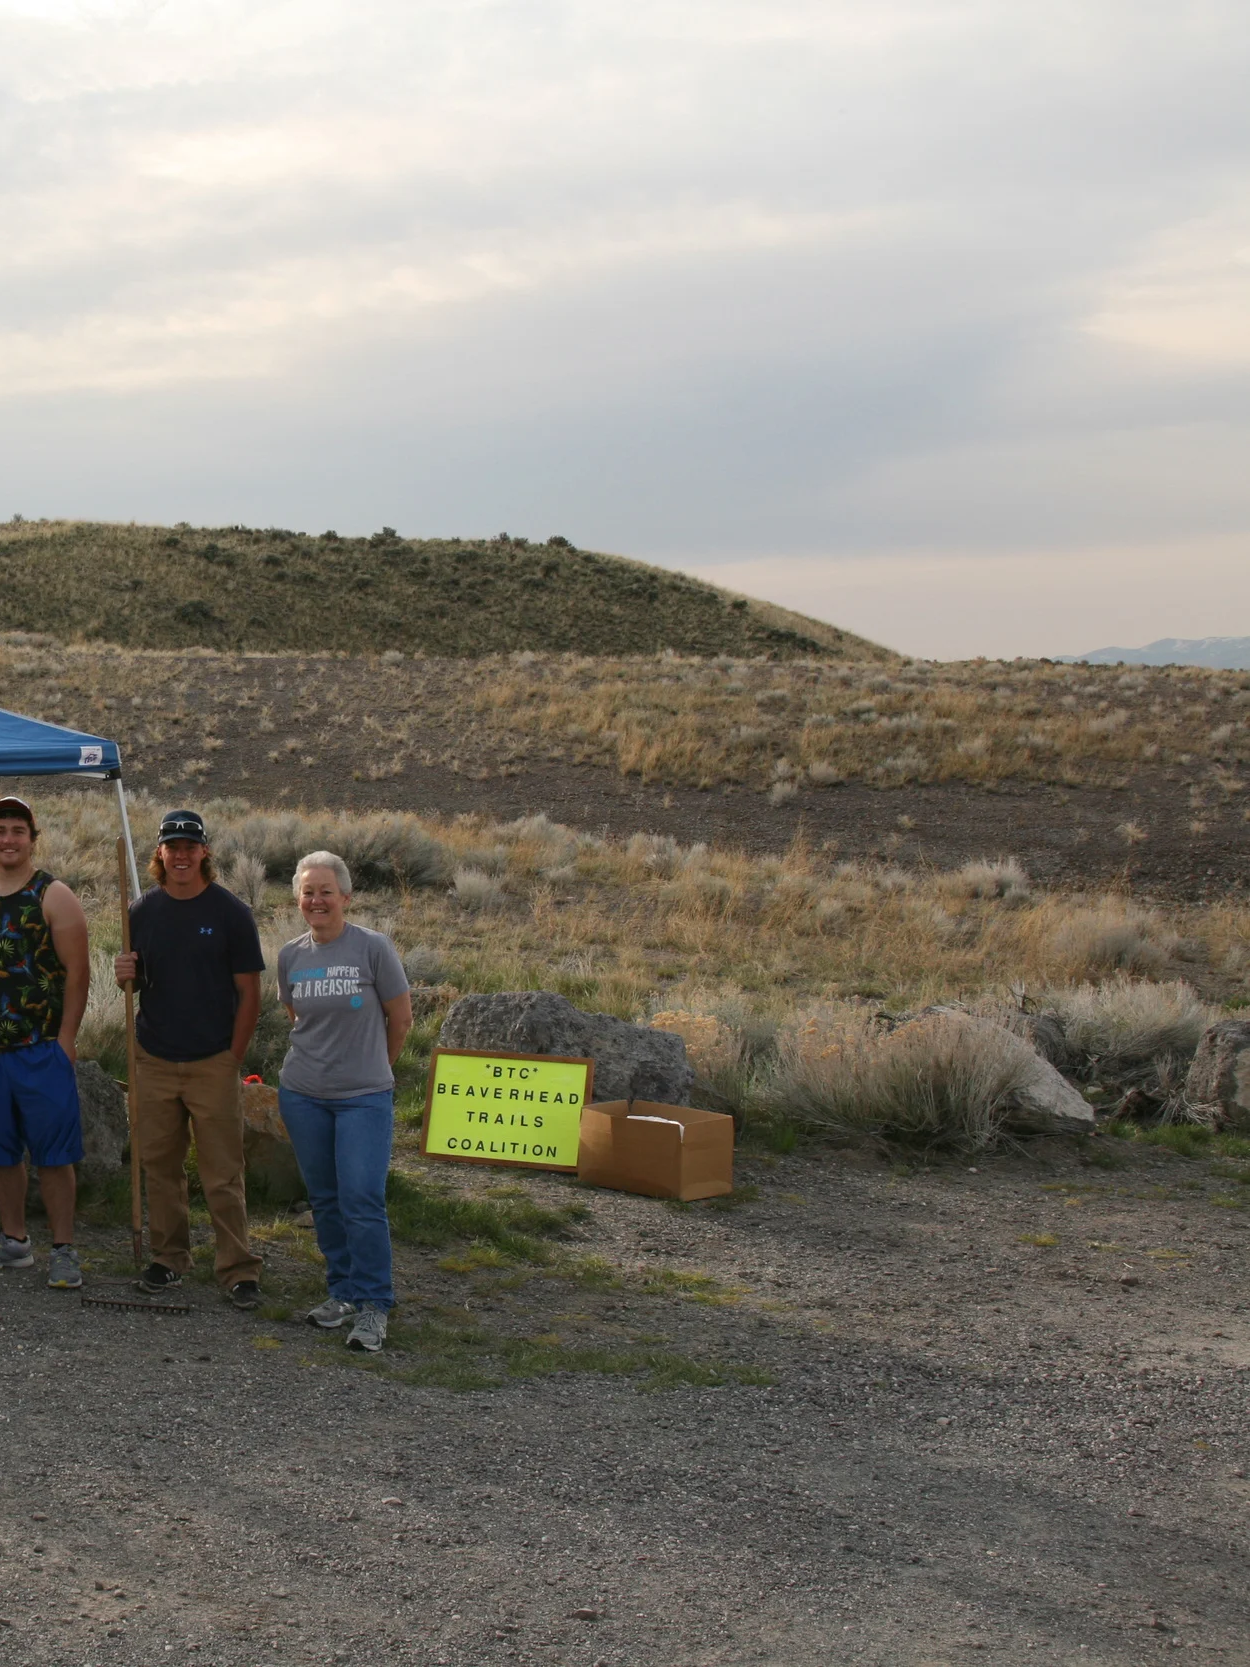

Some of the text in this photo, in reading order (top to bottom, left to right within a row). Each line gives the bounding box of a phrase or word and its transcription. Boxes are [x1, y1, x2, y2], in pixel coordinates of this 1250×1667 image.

[327, 965, 360, 979] HAPPENS
[304, 980, 311, 998] A
[314, 978, 362, 998] REASON.
[437, 1083, 579, 1105] BEAVERHEAD
[466, 1111, 544, 1128] TRAILS
[447, 1137, 557, 1157] COALITION
